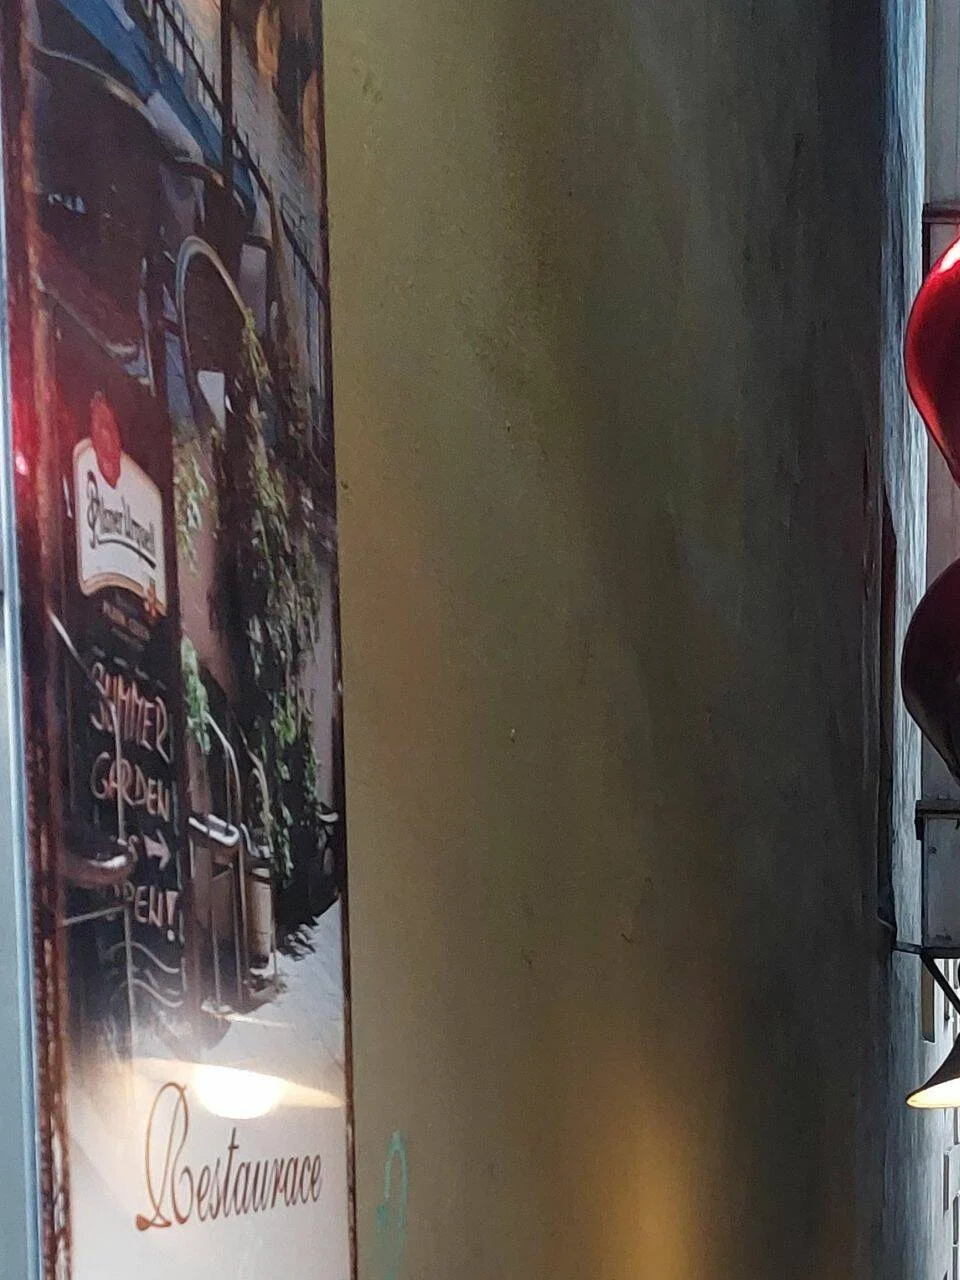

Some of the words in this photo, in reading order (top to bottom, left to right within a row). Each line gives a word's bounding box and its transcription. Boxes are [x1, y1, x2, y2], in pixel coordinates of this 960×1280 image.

[90, 751, 170, 823] GARDEN
[112, 880, 179, 942] PEN!
[135, 1081, 323, 1232] Restaurace
